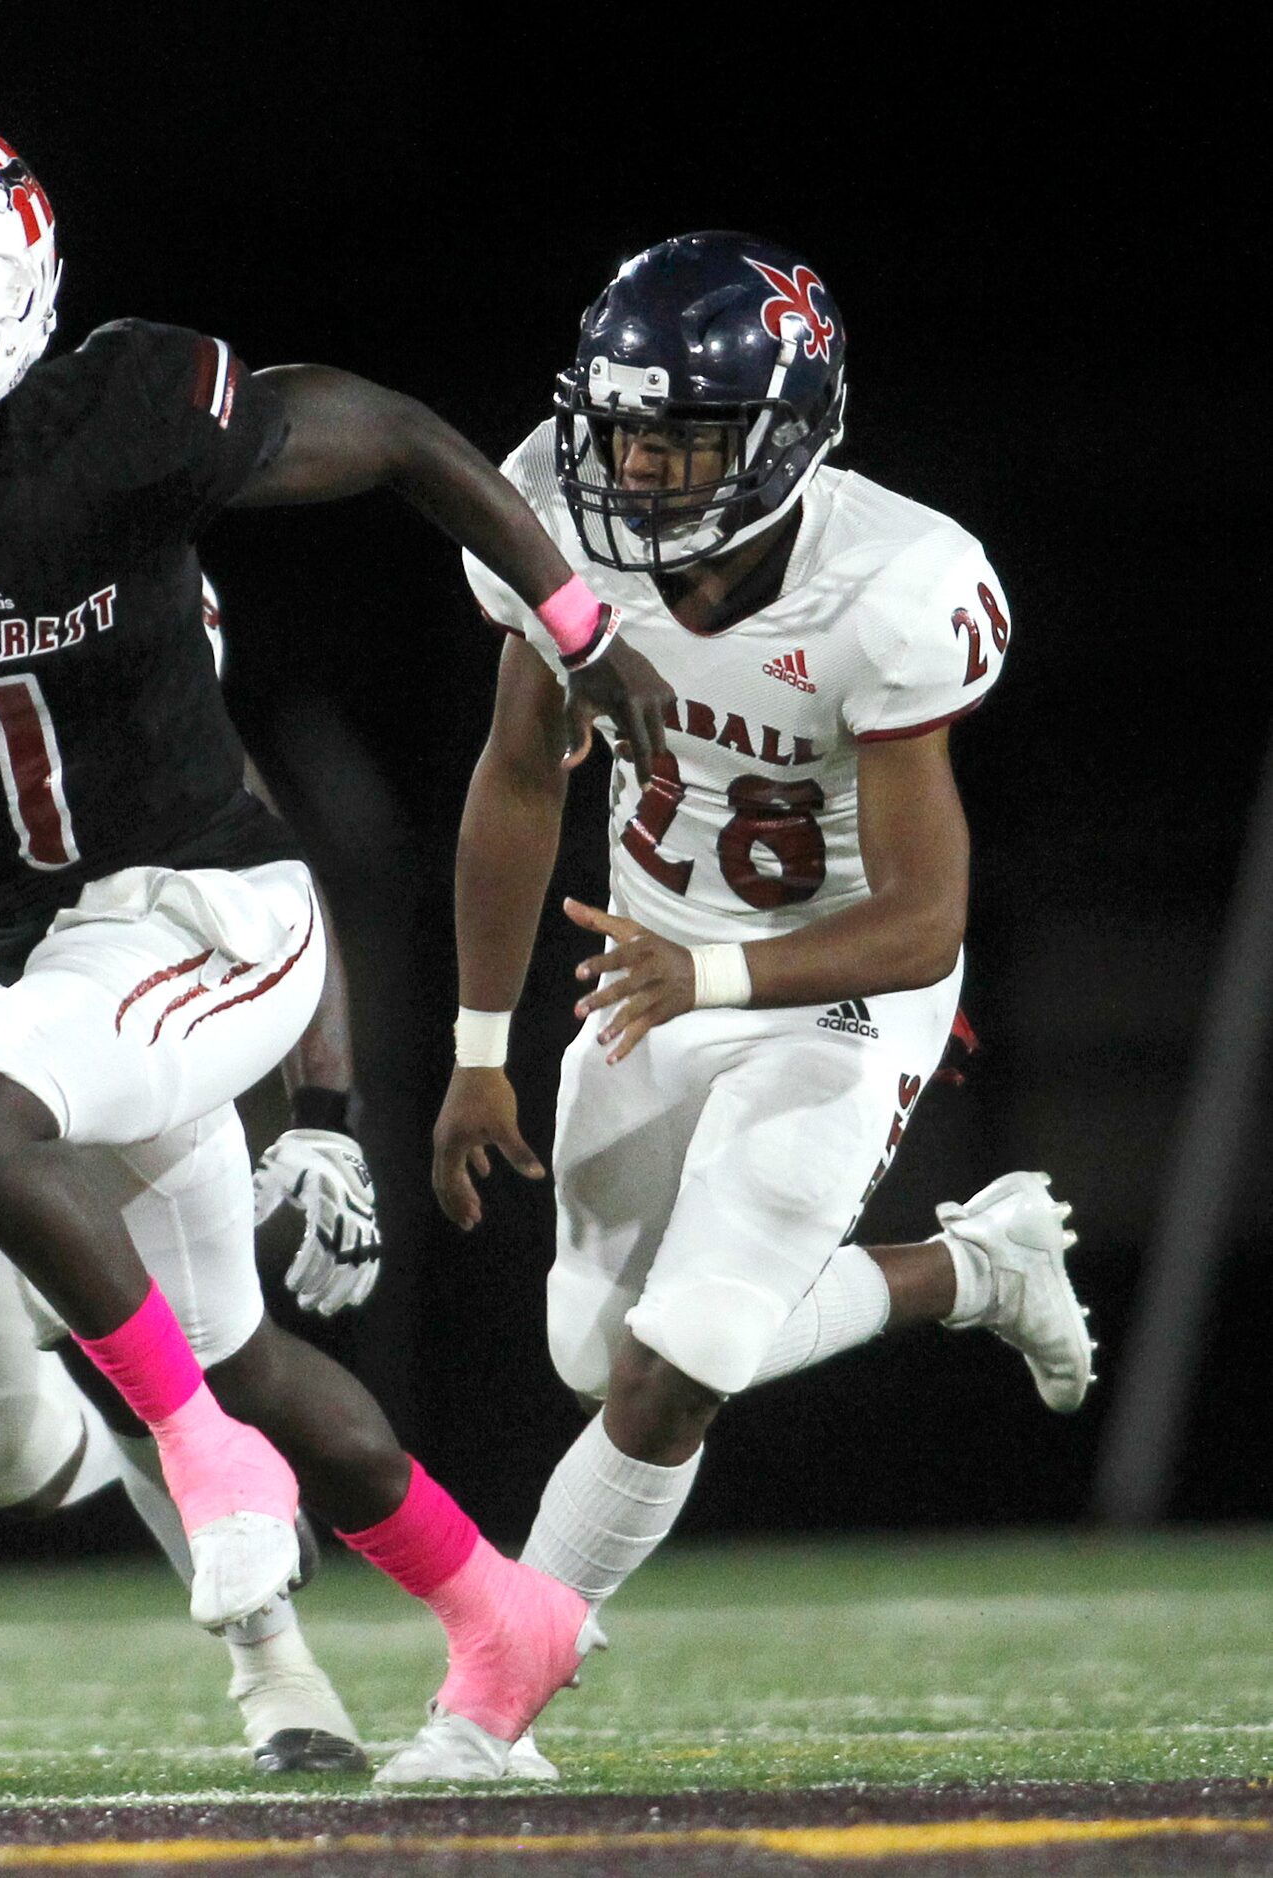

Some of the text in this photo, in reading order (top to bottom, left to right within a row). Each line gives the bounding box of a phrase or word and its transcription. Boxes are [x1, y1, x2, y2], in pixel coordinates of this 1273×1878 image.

[951, 581, 1008, 687] 28
[763, 662, 817, 694] adidas
[616, 746, 826, 910] 28
[816, 1016, 879, 1039] adidas
